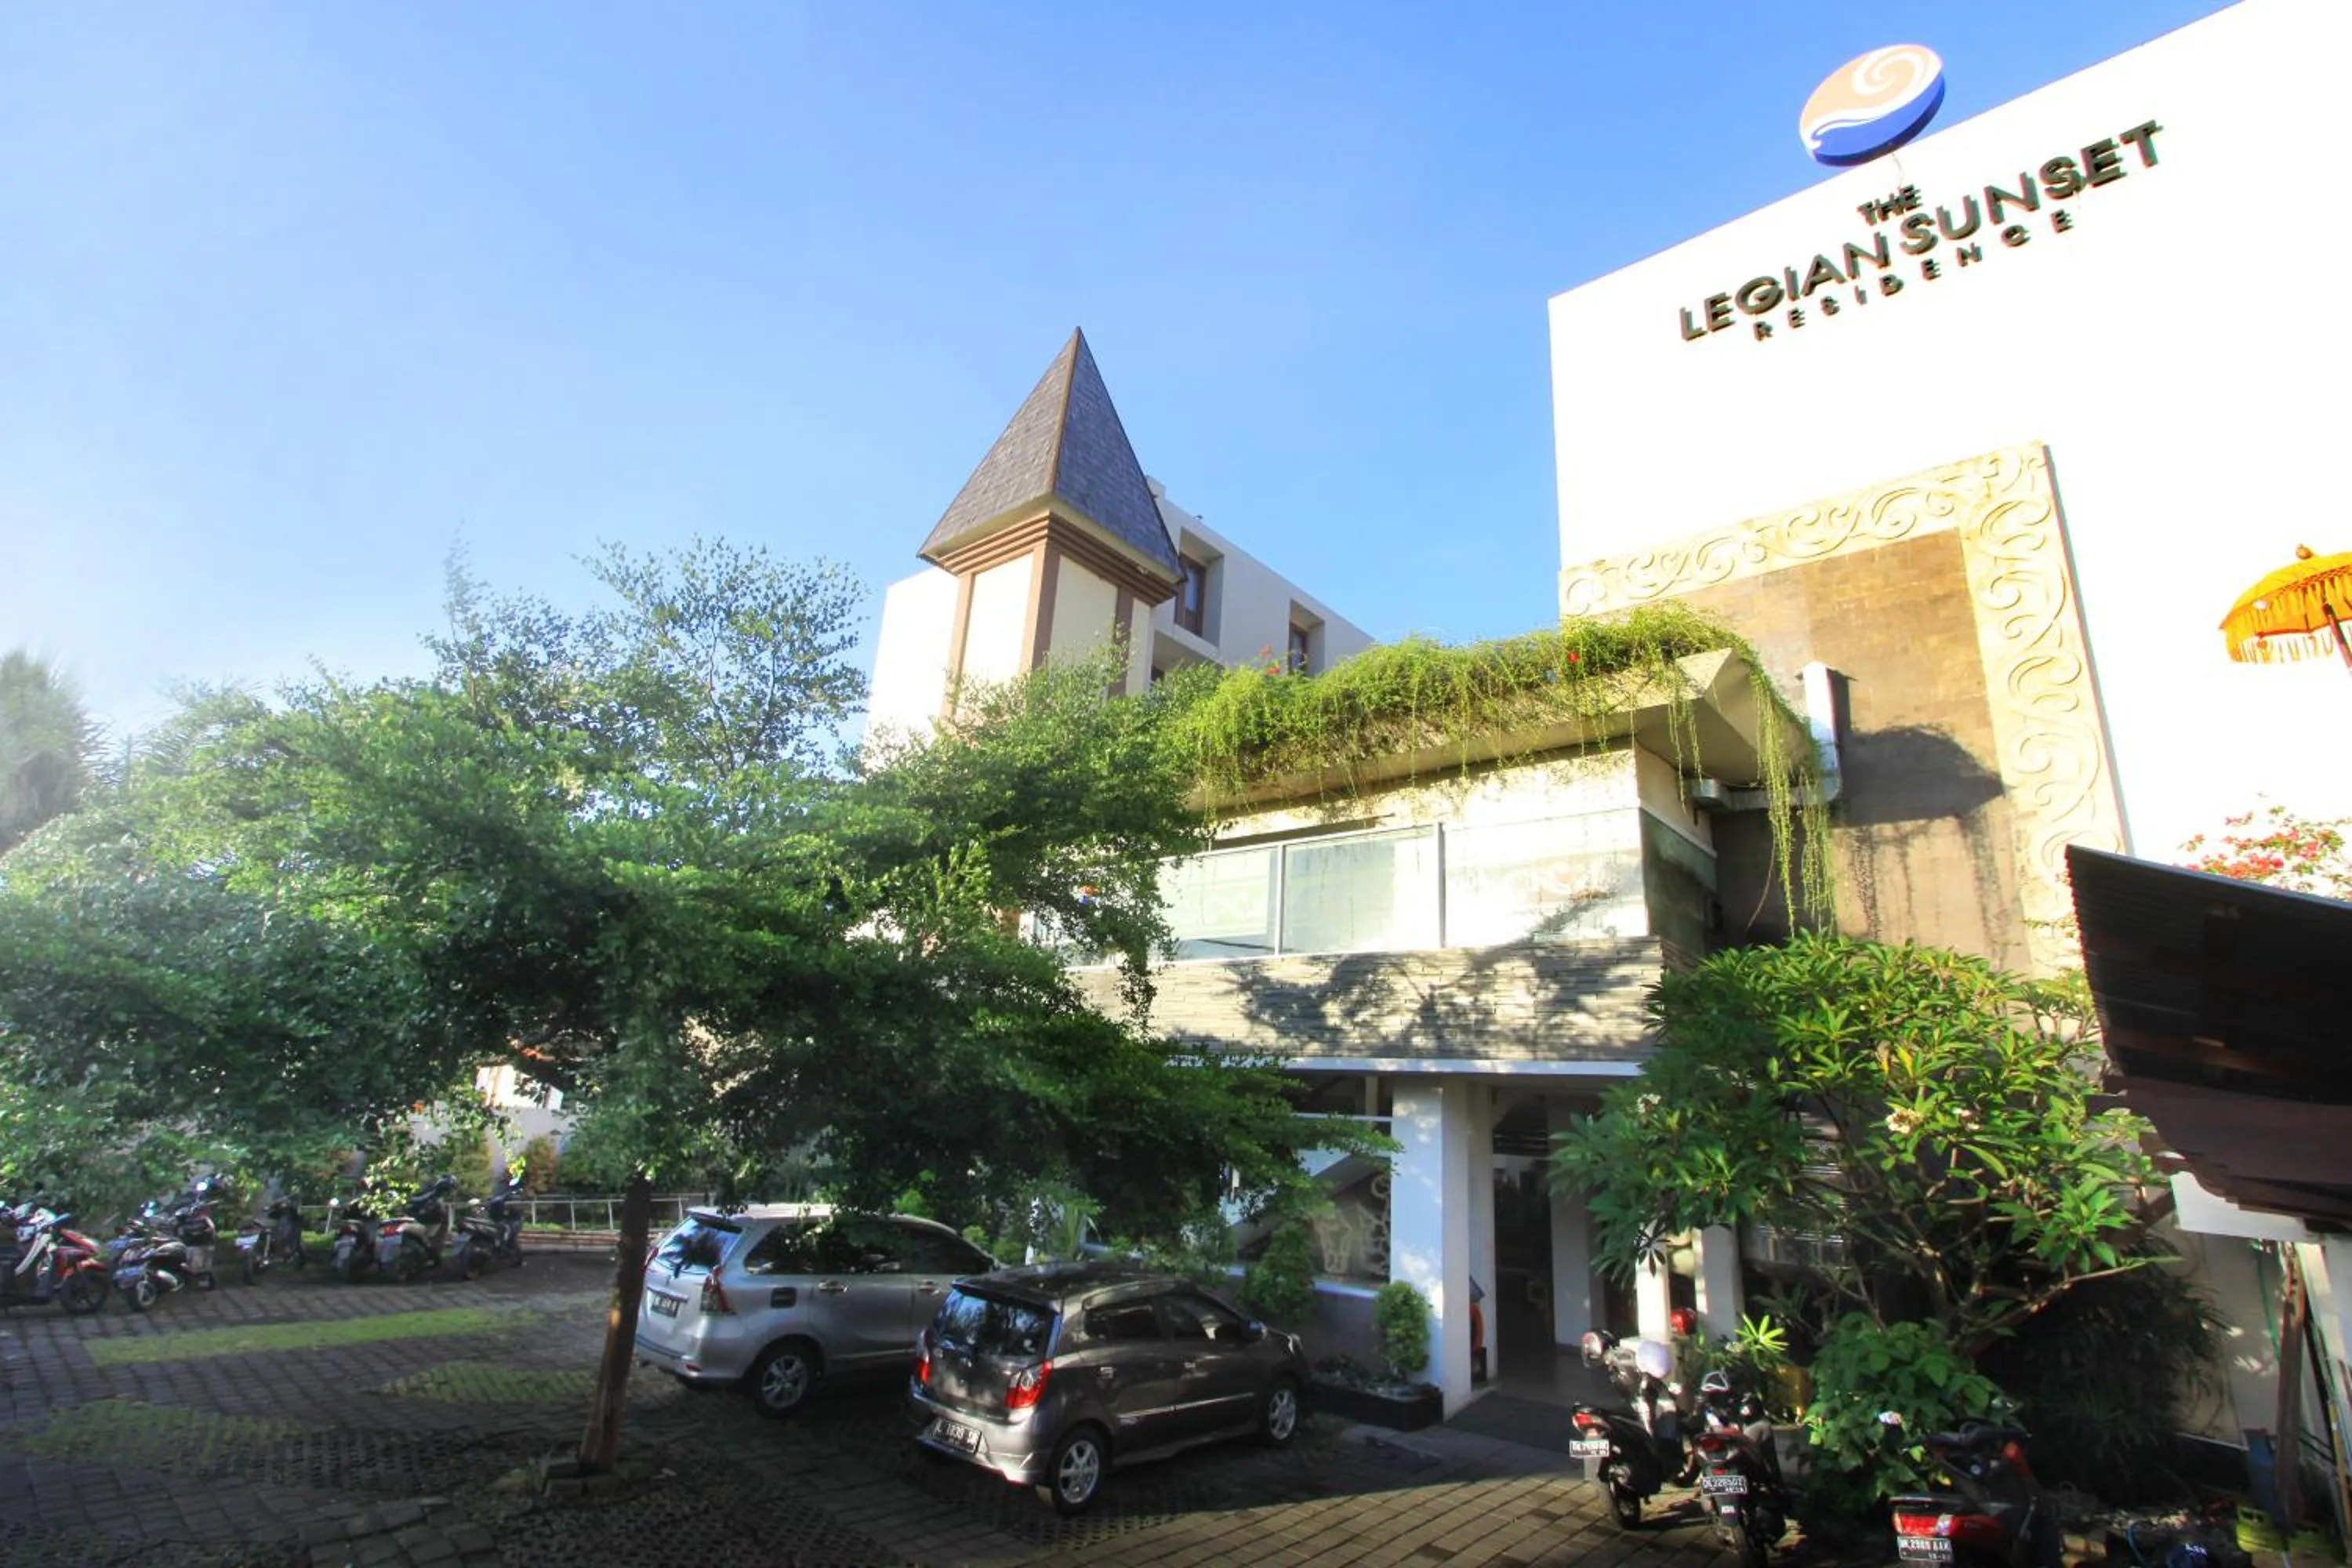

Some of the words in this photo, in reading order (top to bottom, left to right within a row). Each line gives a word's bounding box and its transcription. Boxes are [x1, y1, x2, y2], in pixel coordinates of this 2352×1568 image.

[1679, 231, 1892, 343] LEGIAN
[1899, 119, 2164, 256] SUNSET
[1856, 184, 1923, 227] THE
[1752, 209, 2075, 342] RESIDENCE
